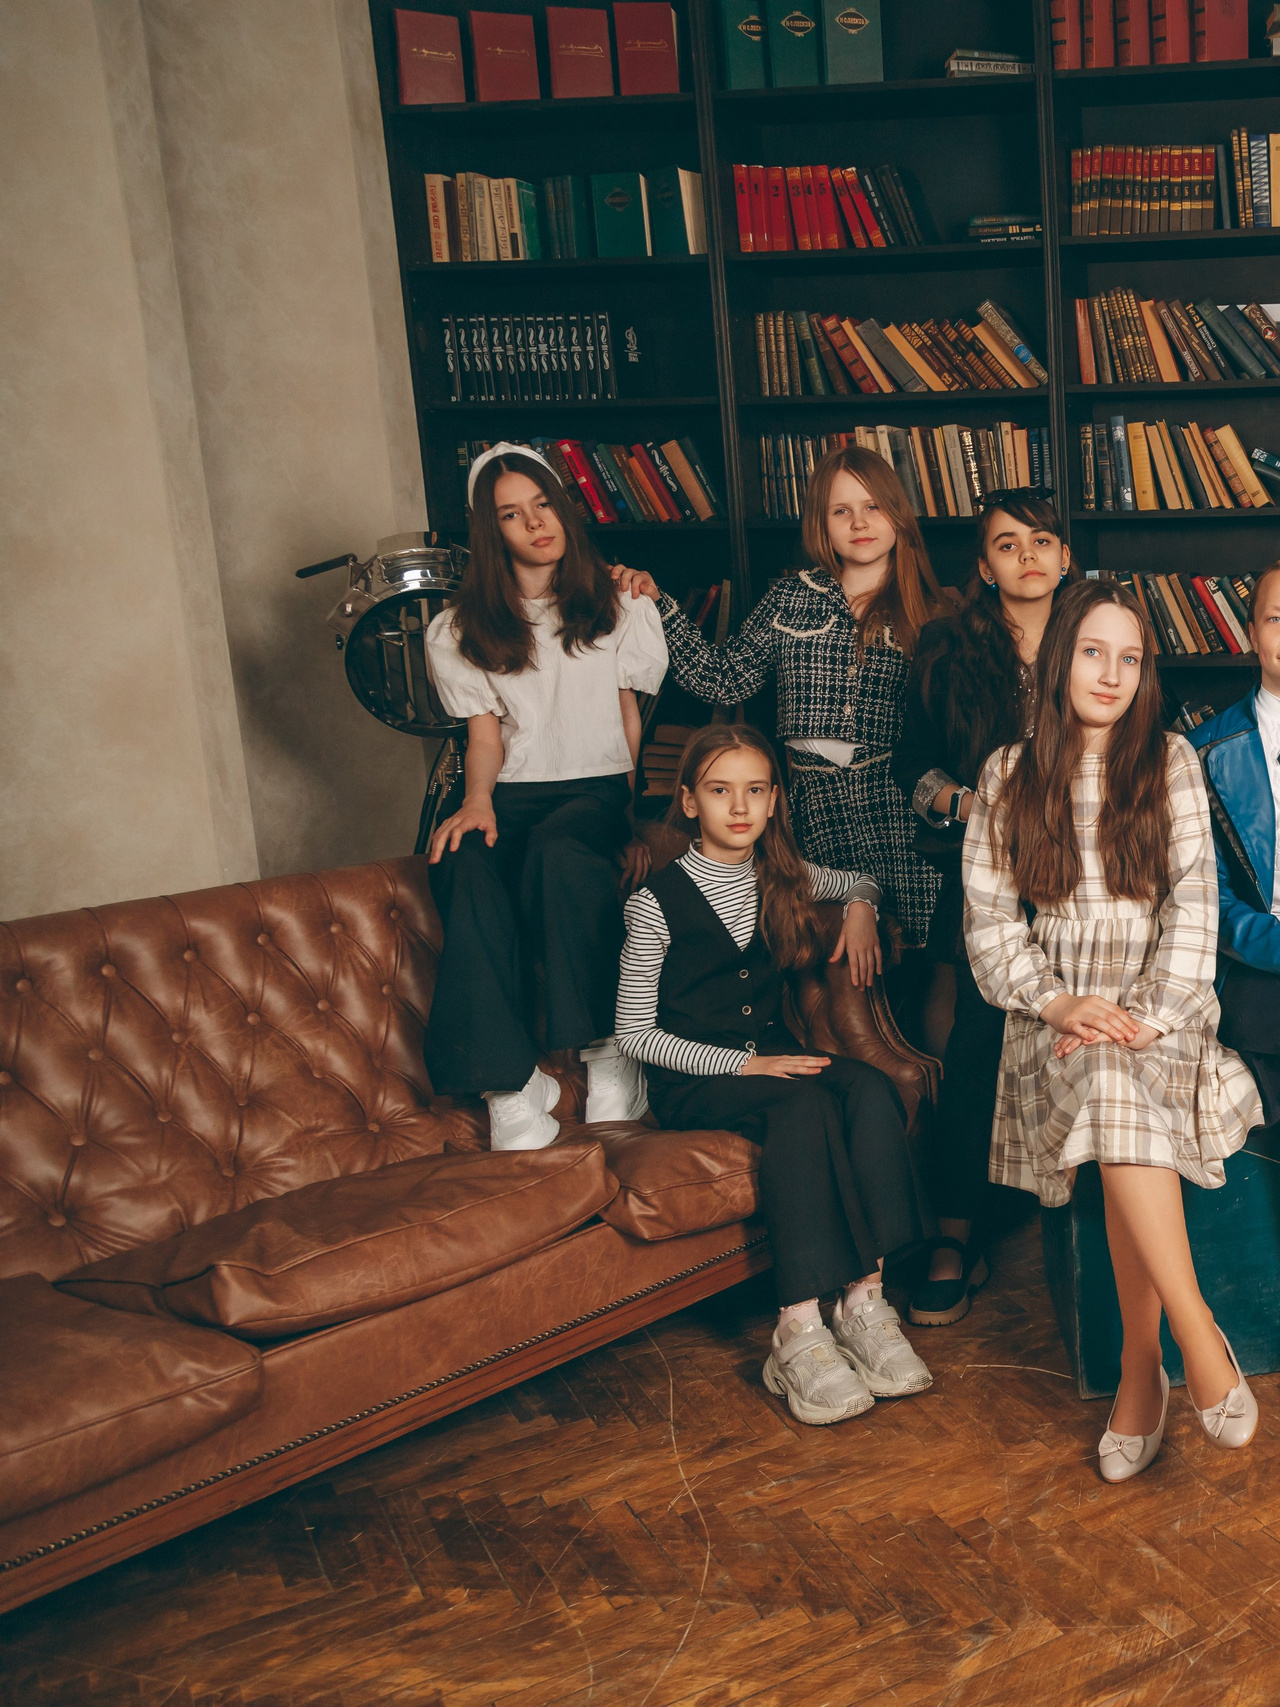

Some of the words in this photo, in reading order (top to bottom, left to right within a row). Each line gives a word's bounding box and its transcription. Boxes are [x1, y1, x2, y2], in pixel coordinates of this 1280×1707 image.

[772, 186, 779, 197] 2
[792, 185, 801, 197] 3
[804, 184, 812, 195] 4
[819, 183, 826, 195] 5
